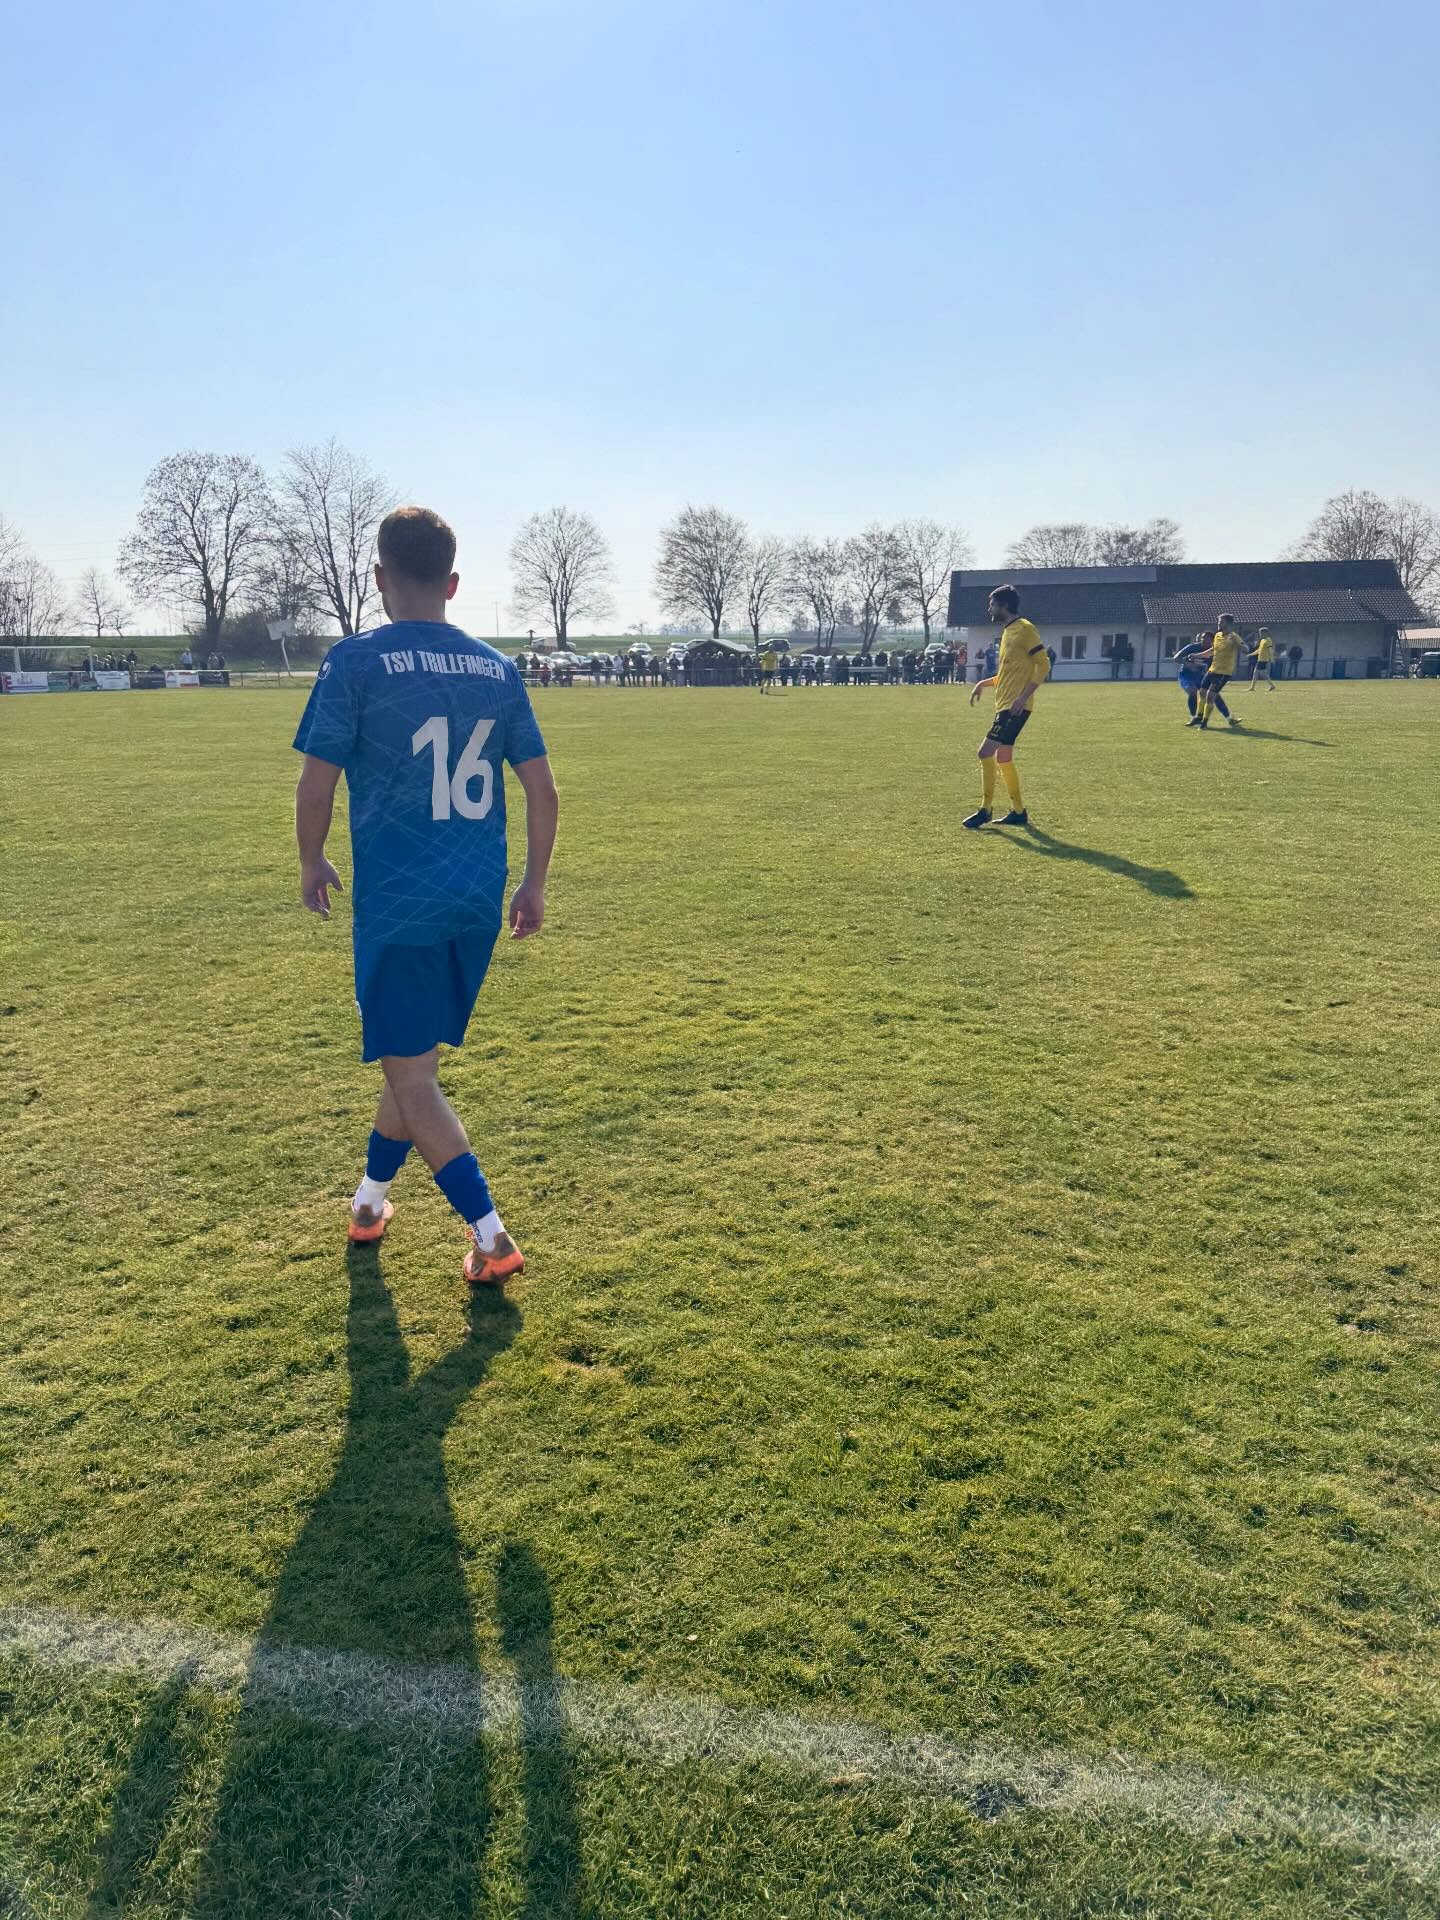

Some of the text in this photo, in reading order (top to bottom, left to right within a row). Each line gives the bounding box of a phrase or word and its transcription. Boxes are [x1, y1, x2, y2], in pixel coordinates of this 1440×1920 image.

[379, 650, 506, 681] TSV TRILLFINGEN
[412, 716, 496, 821] 16
